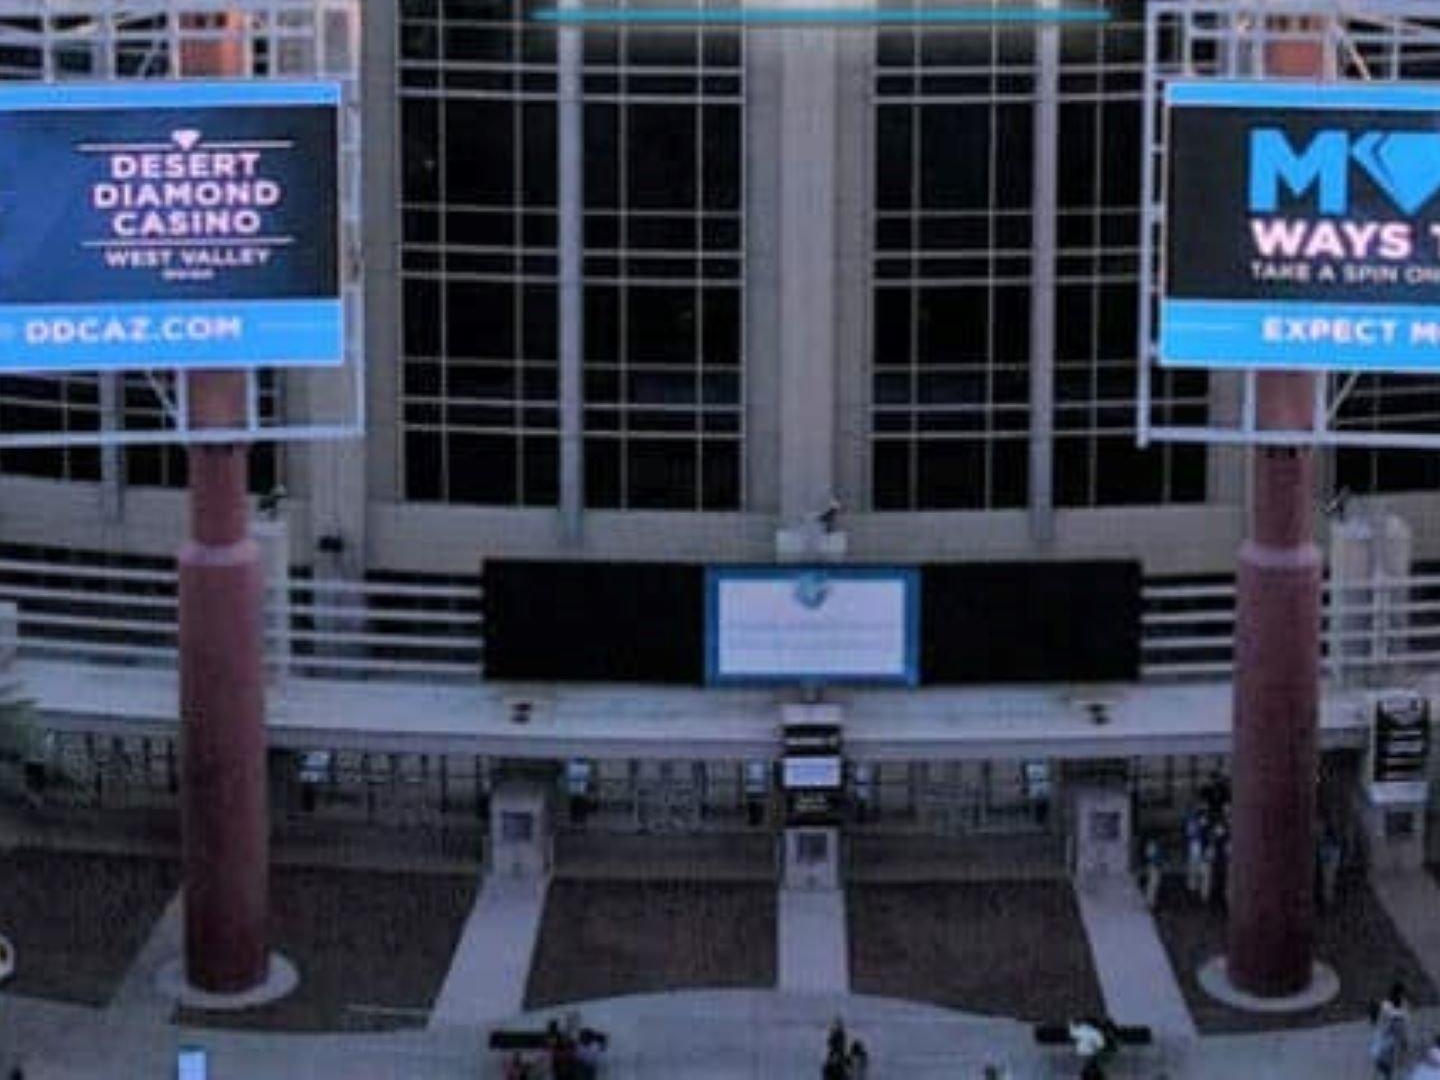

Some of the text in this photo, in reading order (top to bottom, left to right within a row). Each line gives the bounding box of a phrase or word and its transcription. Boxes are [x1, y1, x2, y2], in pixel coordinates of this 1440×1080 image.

[110, 152, 261, 179] DESERT
[92, 181, 280, 209] DIAMOND
[112, 210, 261, 236] CASINO
[1252, 220, 1412, 260] WAYS
[106, 248, 270, 268] WEST VALLEY
[1252, 262, 1309, 281] TAKE
[1318, 263, 1335, 282] A
[1344, 264, 1397, 284] SPIN
[1405, 266, 1440, 284] ON
[25, 317, 242, 344] DDCAZ.COM
[1264, 318, 1394, 345] EXPECT
